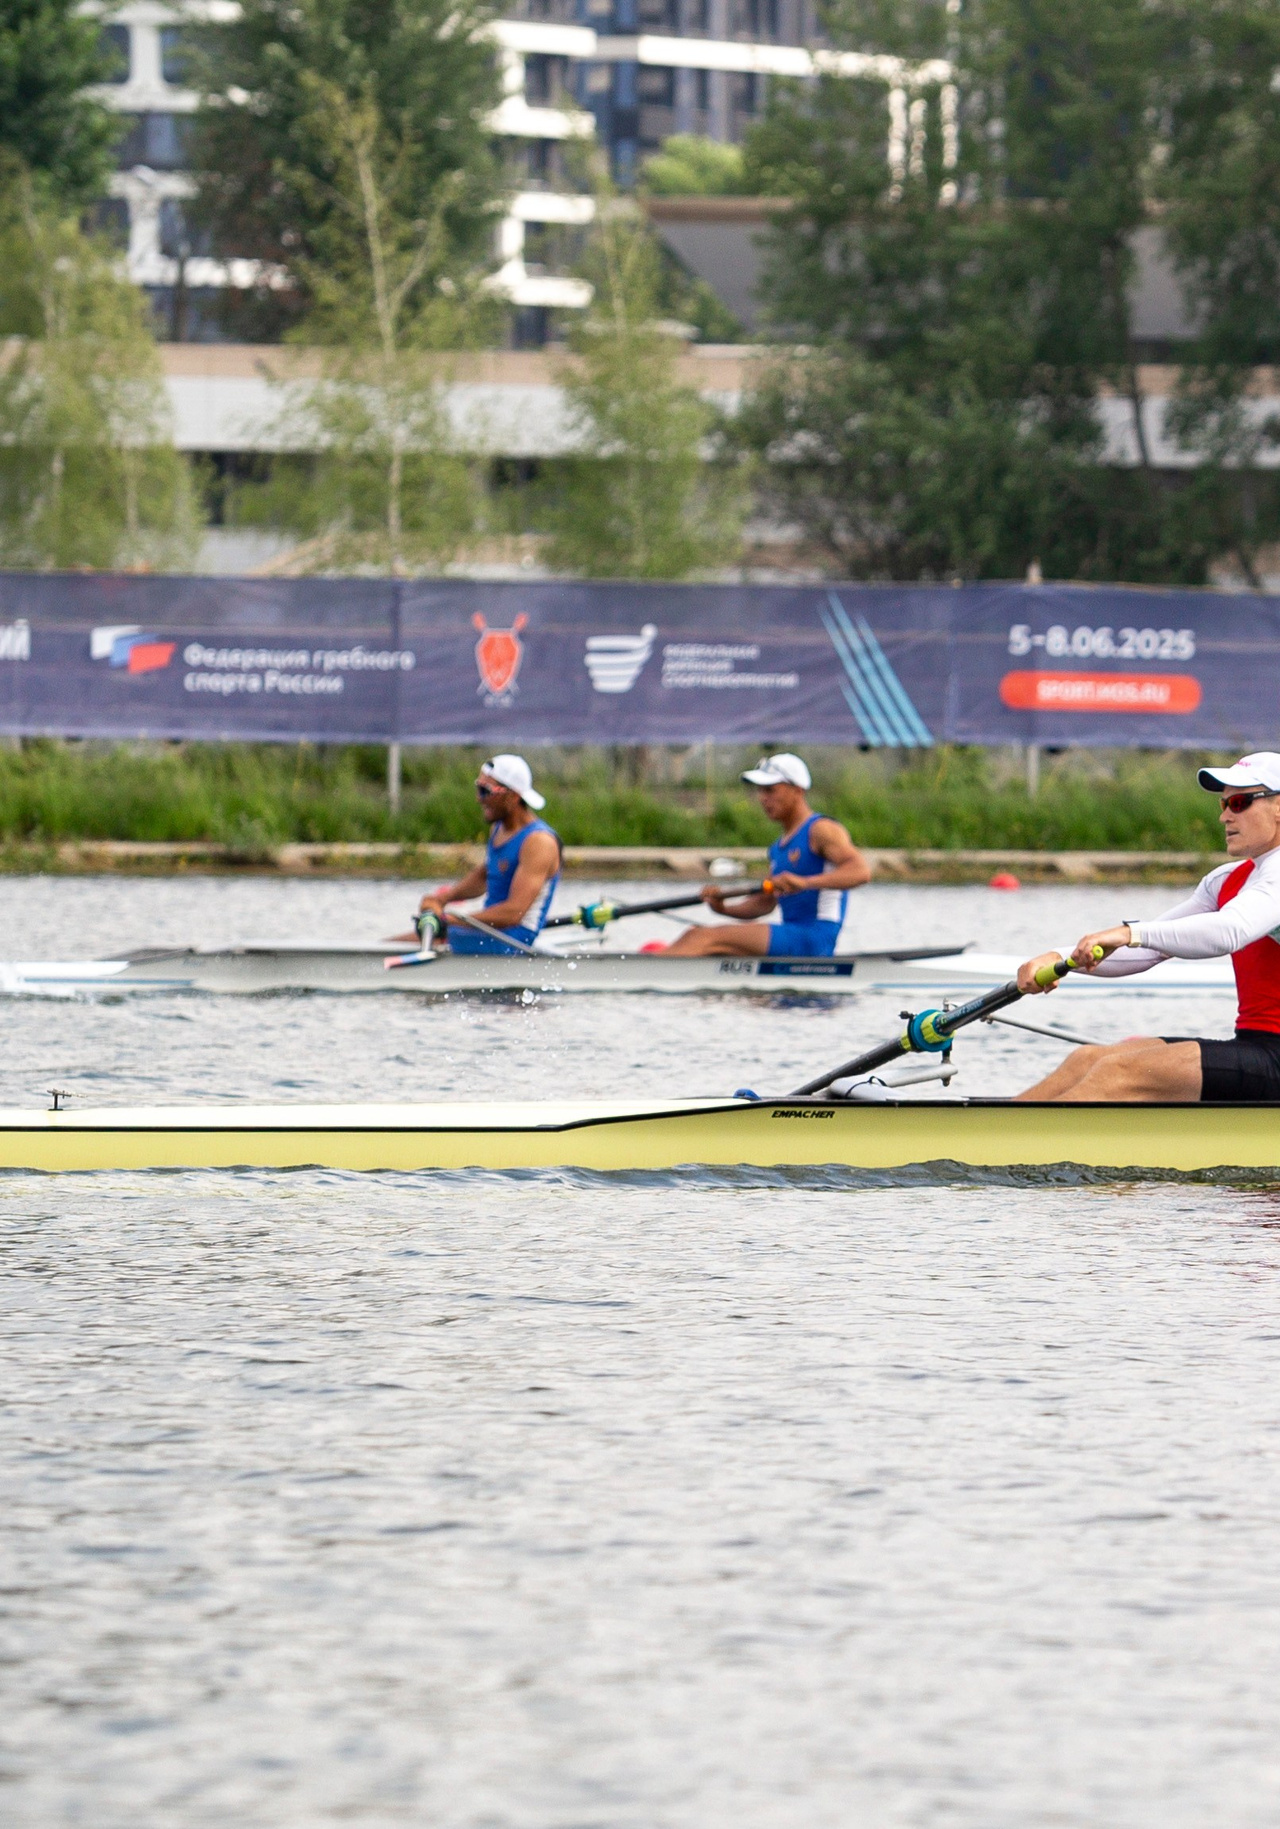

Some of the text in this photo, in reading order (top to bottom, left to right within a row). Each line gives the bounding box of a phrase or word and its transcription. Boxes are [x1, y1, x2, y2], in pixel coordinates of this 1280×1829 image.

[1008, 624, 1196, 660] 5-8.06.2025
[184, 643, 416, 673] Федерация гребного
[184, 669, 344, 696] спорта России
[719, 960, 754, 976] RUS
[771, 1110, 836, 1118] EMPACHER
